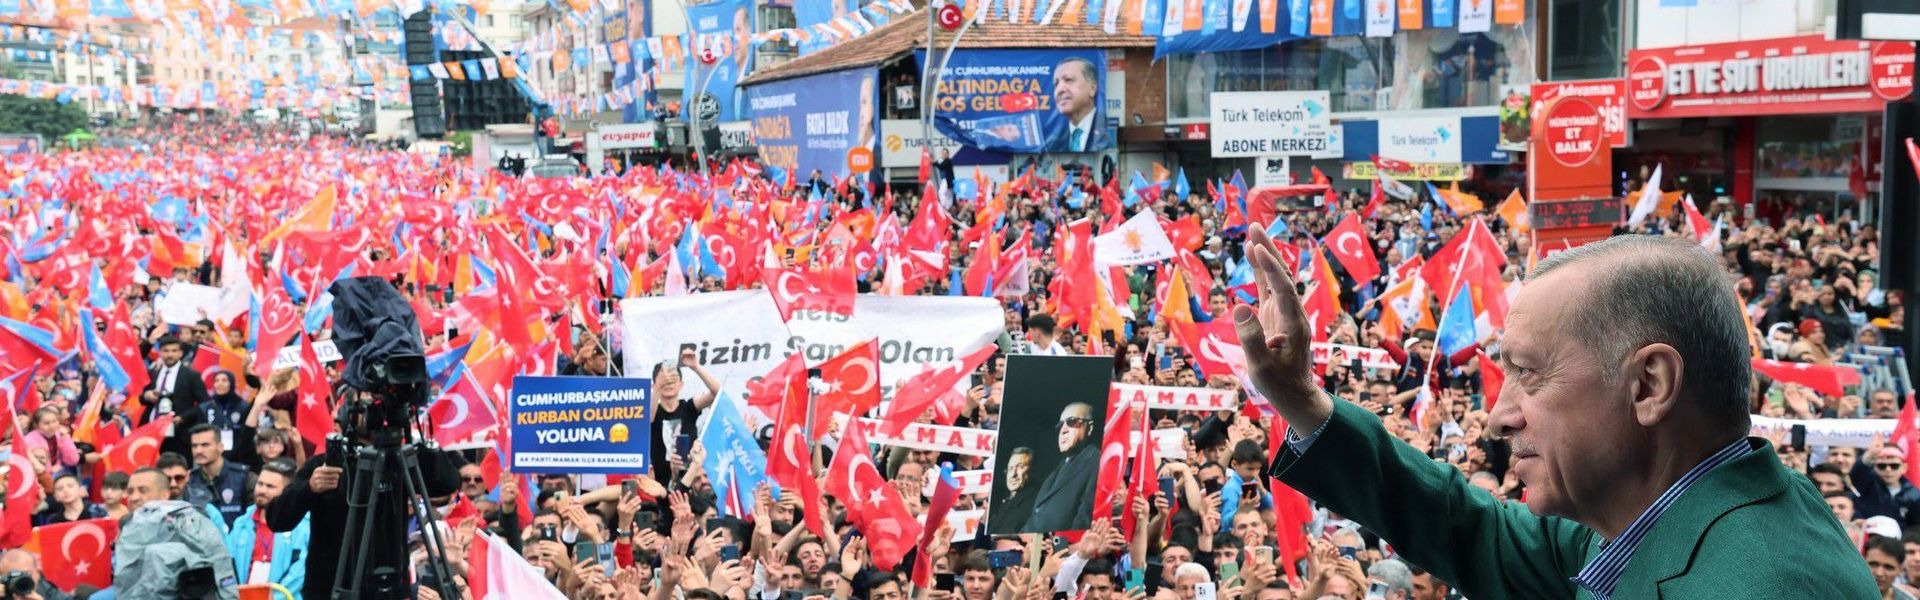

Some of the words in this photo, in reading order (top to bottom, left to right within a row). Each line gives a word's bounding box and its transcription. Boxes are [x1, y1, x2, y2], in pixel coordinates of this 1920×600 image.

[1667, 63, 1692, 95] ET
[1693, 61, 1721, 93] VE
[1722, 51, 1761, 93] SÜT
[1762, 41, 1869, 91] ÜRÜNLERİ
[1887, 64, 1904, 76] ET
[1877, 75, 1913, 88] BALIK
[1222, 108, 1249, 122] Türk
[1252, 108, 1304, 122] Telekom
[601, 130, 651, 142] evyapar
[1565, 127, 1582, 140] ET
[1223, 140, 1267, 153] ABONE
[1555, 140, 1593, 154] BALIK
[879, 340, 954, 364] Olan
[516, 389, 645, 407] CUMHURBAŞKANIM
[516, 408, 580, 425] KURBAN
[583, 405, 644, 421] OLURUZ
[536, 427, 605, 444] YOLUNA
